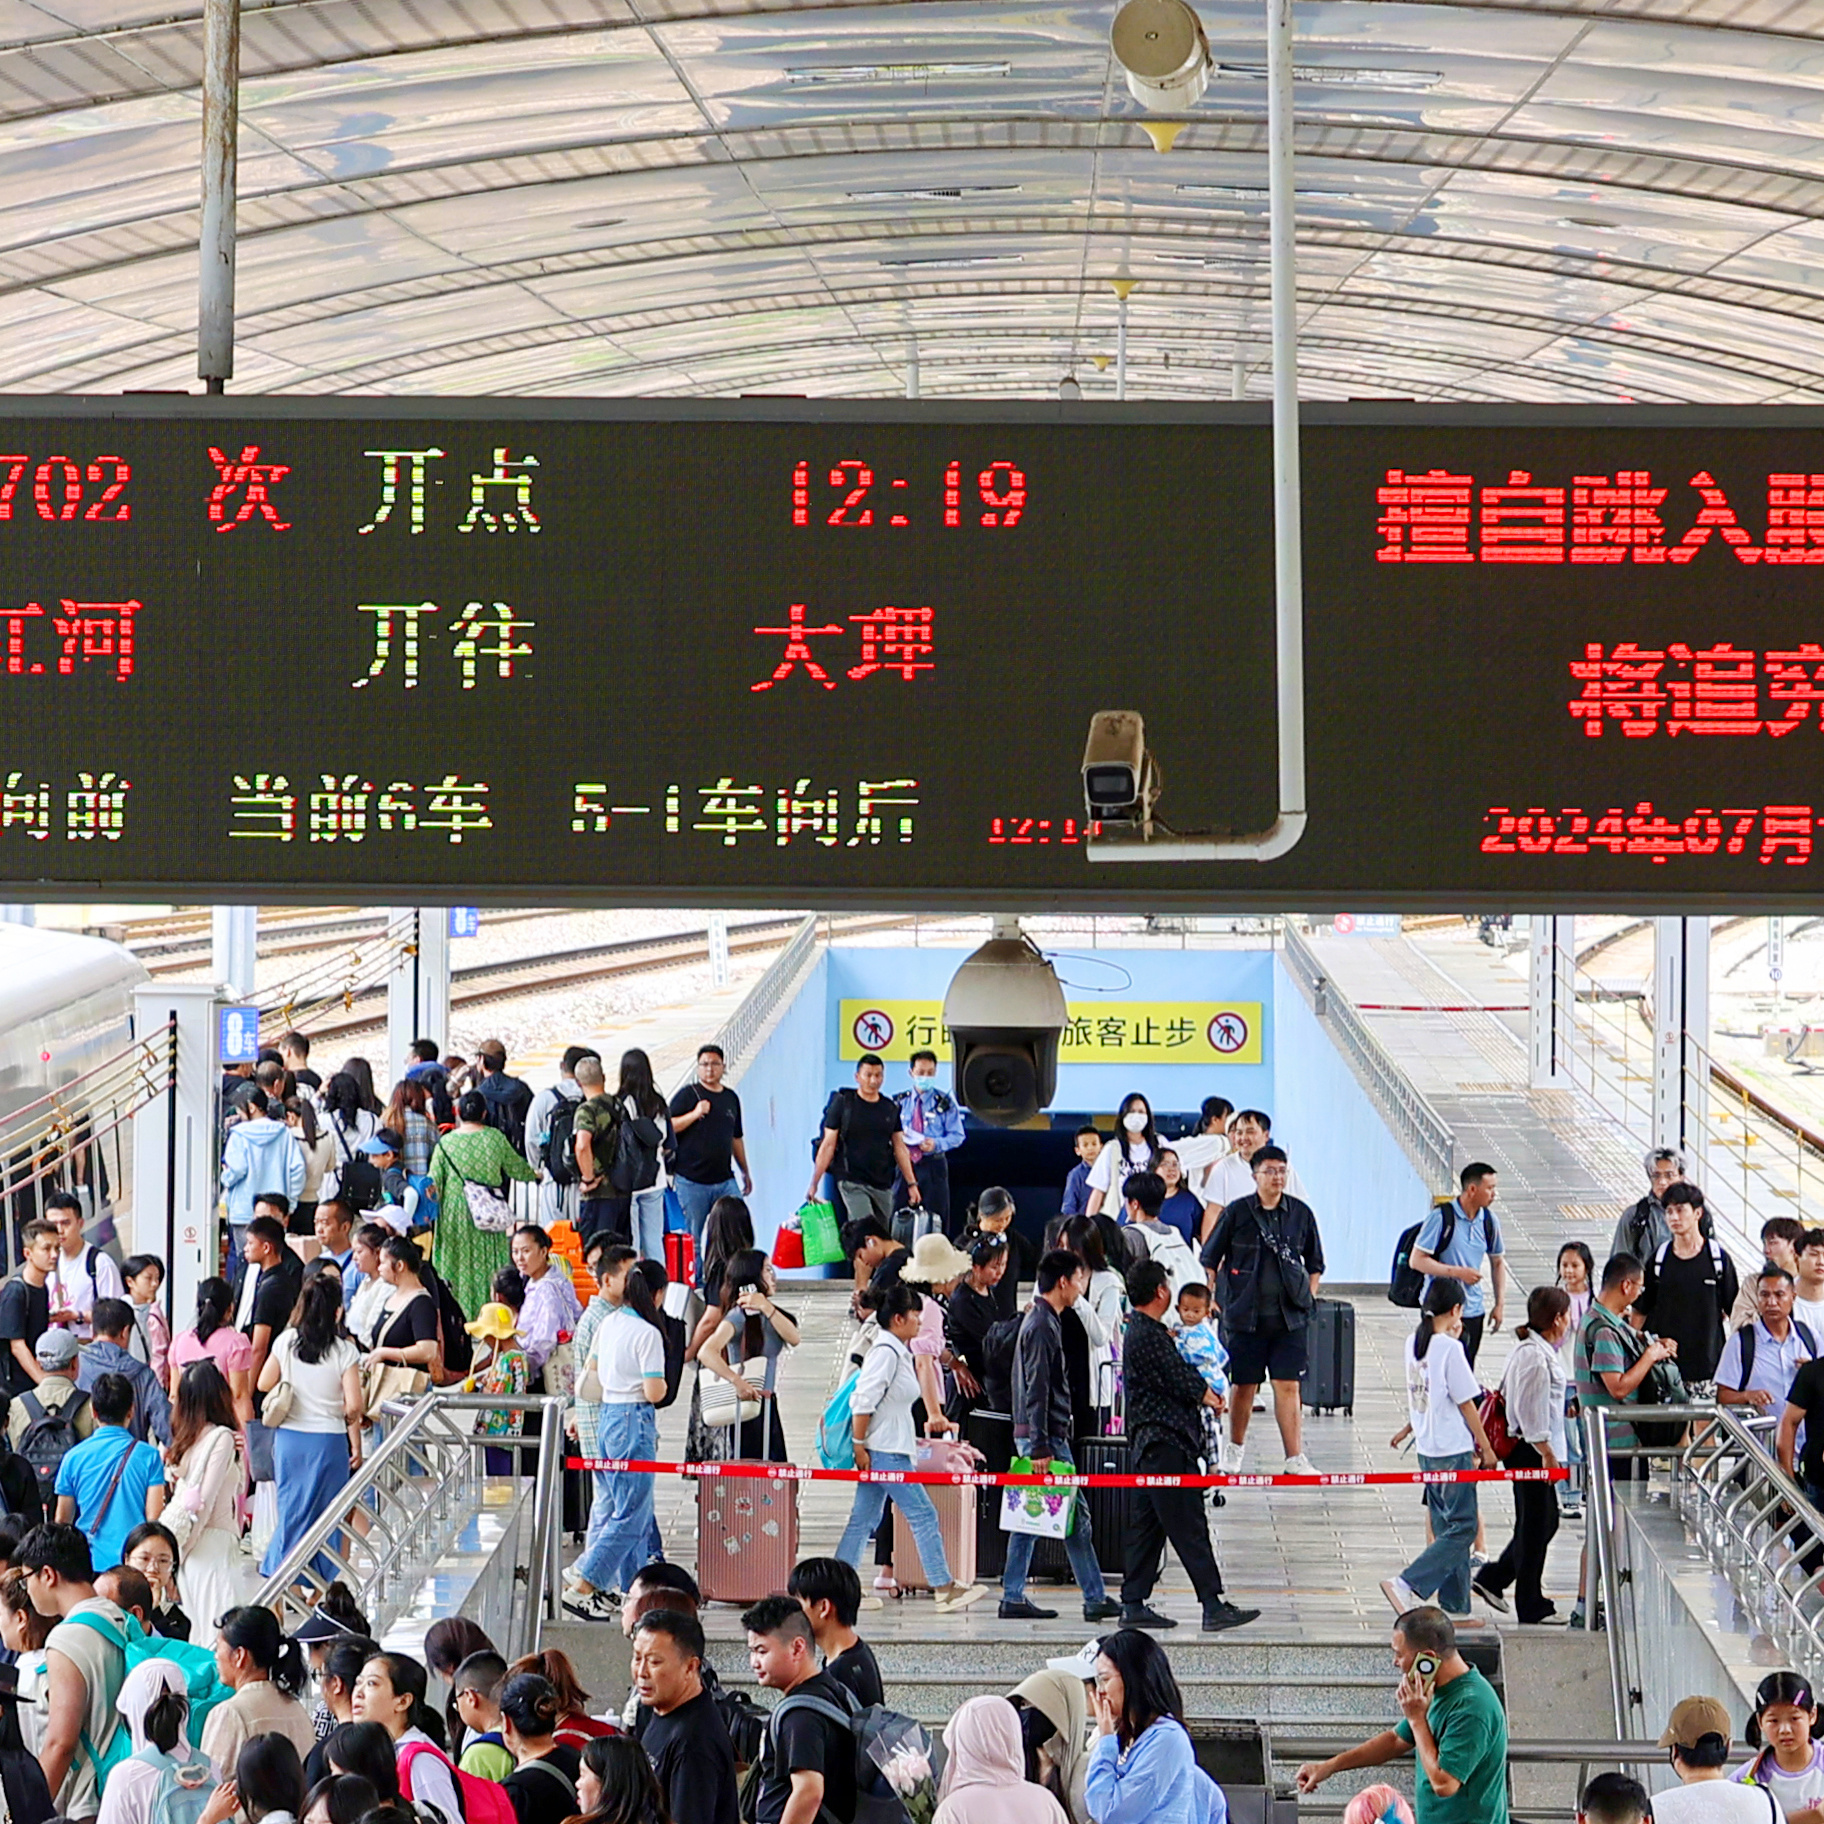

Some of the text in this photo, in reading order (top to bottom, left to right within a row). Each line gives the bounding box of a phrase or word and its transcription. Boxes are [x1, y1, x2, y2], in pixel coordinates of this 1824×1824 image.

[207, 445, 291, 533] 次
[792, 460, 1027, 527] 12:19
[750, 604, 935, 692] 大理
[229, 773, 494, 843] 当前6车
[572, 778, 919, 846] 5-1车向后
